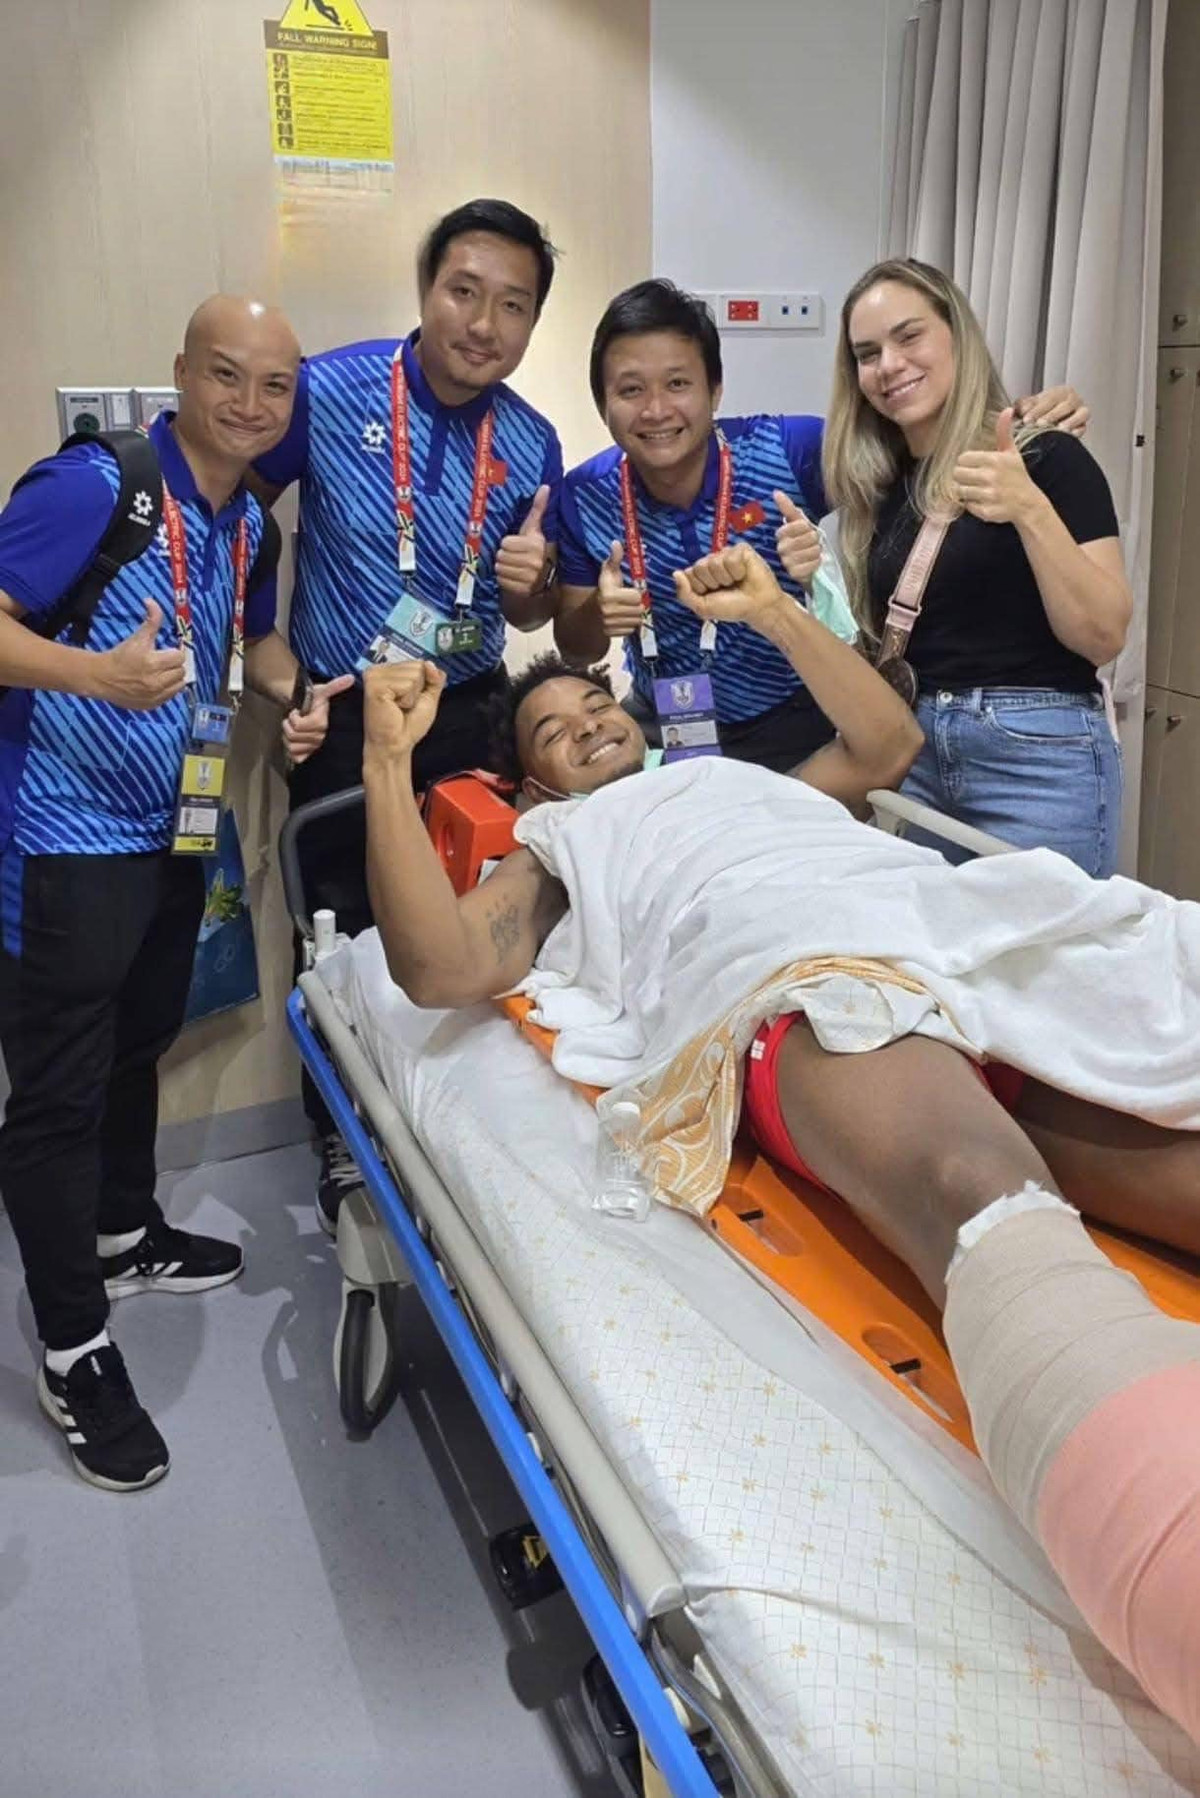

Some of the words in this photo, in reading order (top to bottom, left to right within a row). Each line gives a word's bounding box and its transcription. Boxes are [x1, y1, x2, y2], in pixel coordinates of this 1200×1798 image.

[277, 31, 300, 41] FALL
[304, 34, 350, 47] WARNING
[396, 405, 406, 441] ELECTRIC
[397, 443, 407, 461] CUP
[477, 480, 486, 497] CUP
[172, 541, 182, 560] CUP
[629, 538, 639, 555] CUP
